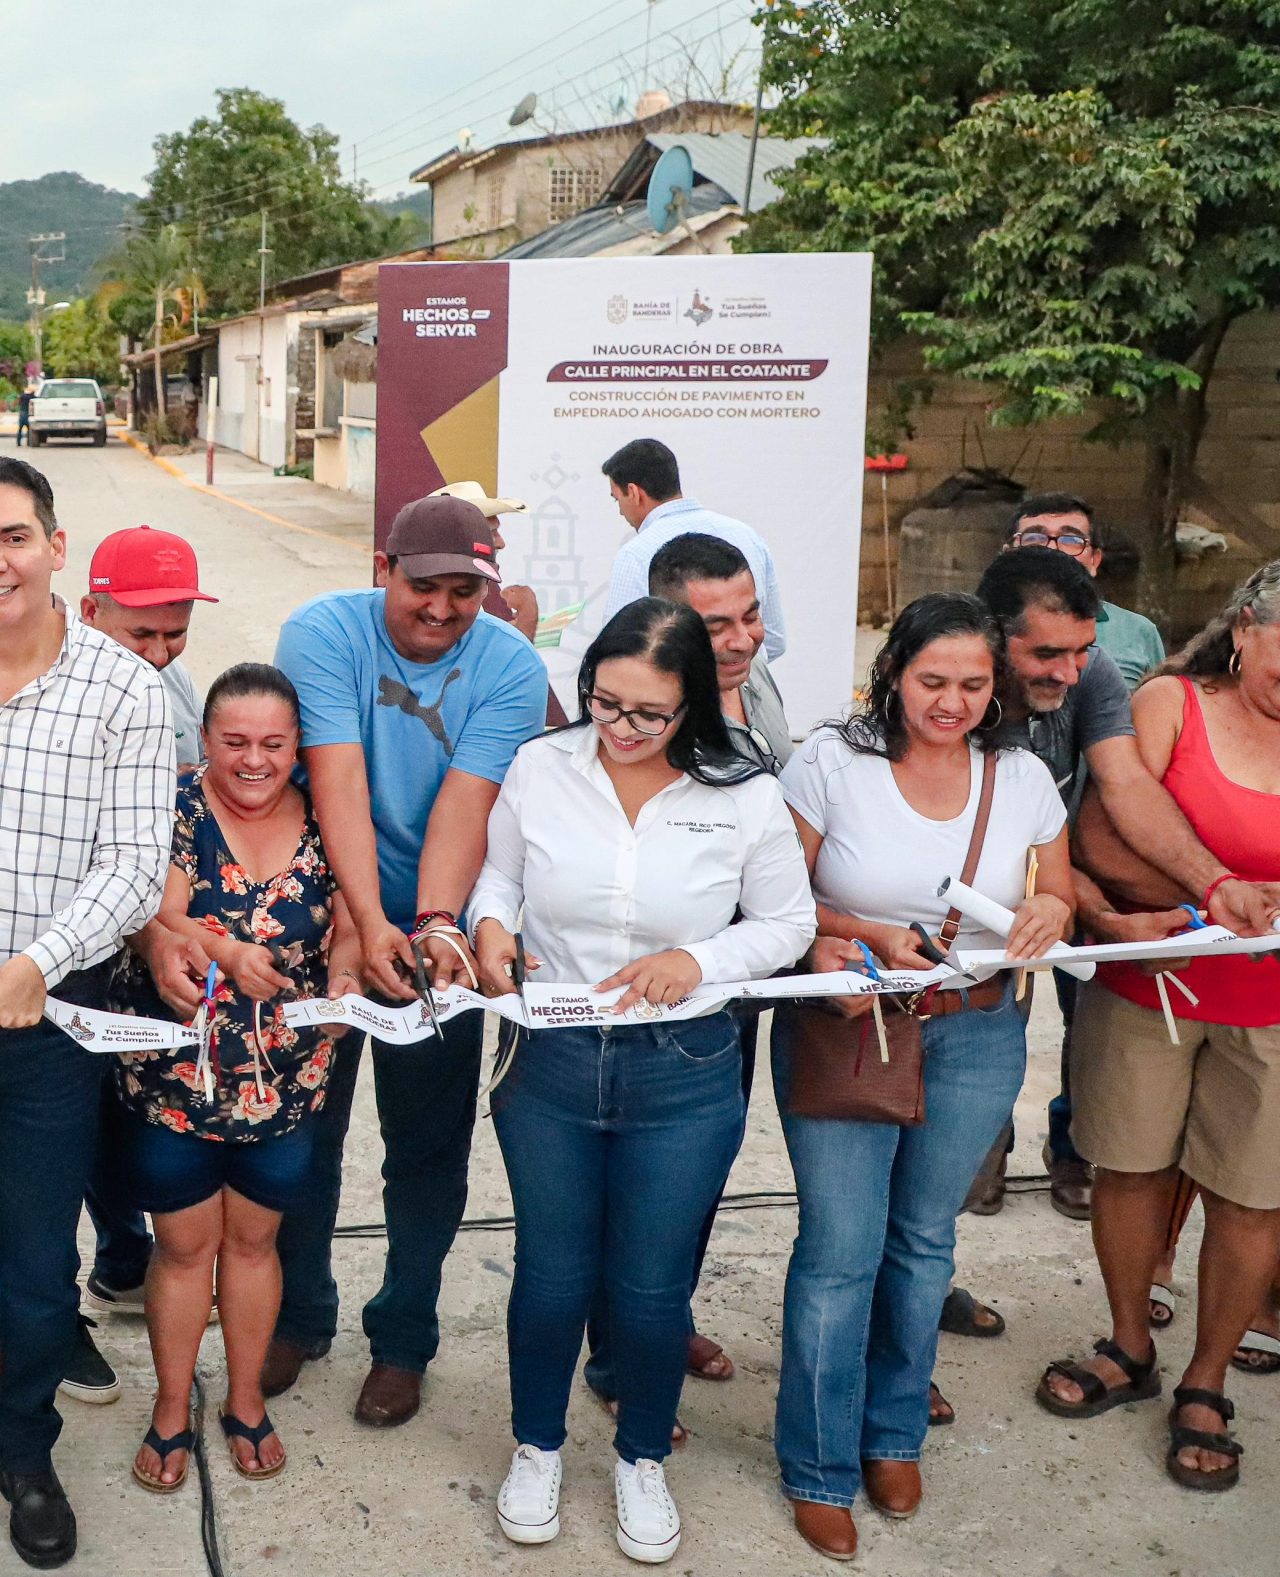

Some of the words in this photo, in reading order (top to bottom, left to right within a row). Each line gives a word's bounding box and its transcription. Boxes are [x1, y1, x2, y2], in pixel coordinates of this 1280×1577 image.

[426, 297, 467, 306] ESTAMOS
[402, 308, 470, 322] HECHOS
[416, 323, 477, 337] SERVIR
[593, 340, 711, 355] INAUGURACIÓN
[716, 344, 736, 355] DE
[740, 343, 784, 354] OBRA
[564, 365, 609, 378] CALLE
[611, 365, 687, 378] PRINCIPAL
[689, 365, 708, 377] EN
[711, 365, 729, 377] EL
[730, 364, 811, 377] COATANTE
[569, 388, 678, 401] CONSTRUCCIÓN
[681, 391, 699, 401] DE
[702, 391, 783, 401] PAVIMENTO
[786, 390, 805, 401] EN
[553, 407, 639, 418] EMPEDRADO
[642, 407, 714, 418] AHOGADO
[716, 407, 747, 418] CON
[750, 407, 821, 418] MORTERO
[531, 1005, 594, 1016] HECHOS
[351, 1010, 397, 1031] BANDERAS
[547, 1016, 605, 1024] SERVIR
